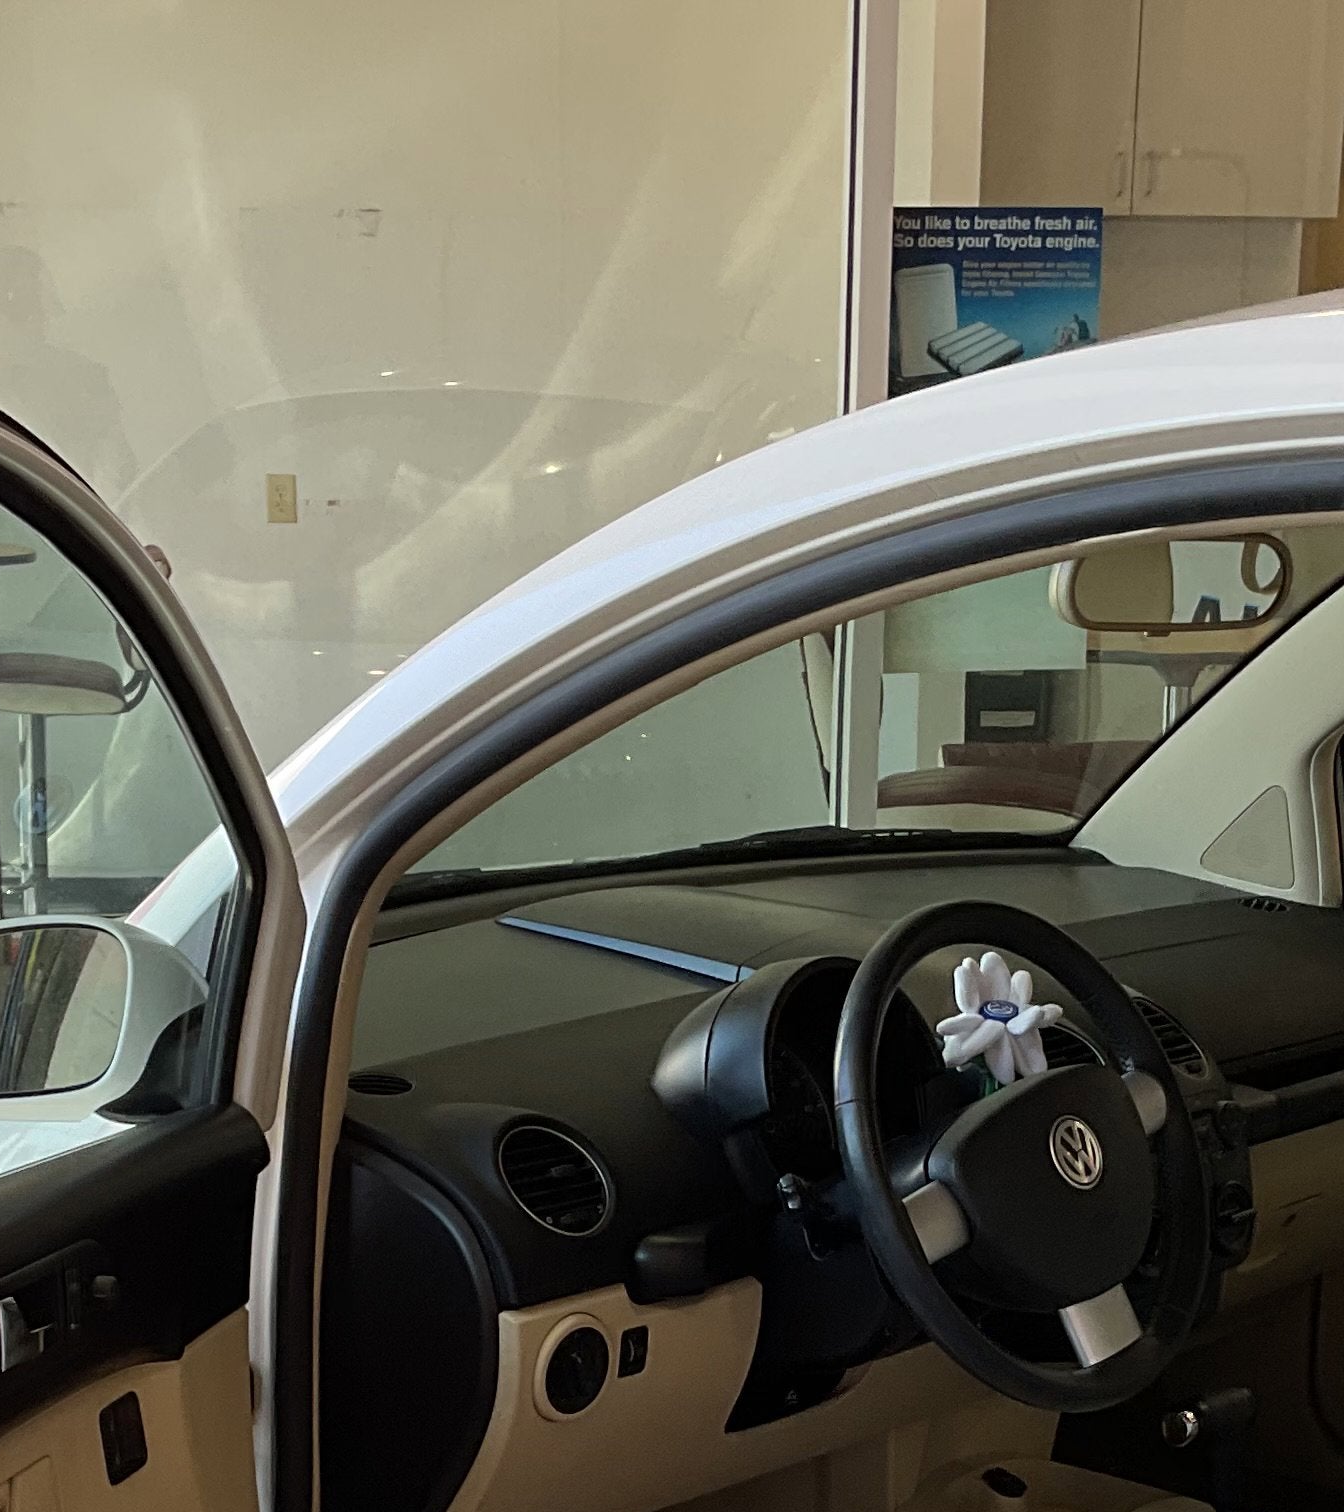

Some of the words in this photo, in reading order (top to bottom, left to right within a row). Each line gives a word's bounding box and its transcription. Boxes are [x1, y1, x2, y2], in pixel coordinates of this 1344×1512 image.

[894, 216, 921, 230] You
[925, 216, 951, 230] like
[955, 216, 970, 230] to
[974, 216, 1031, 230] breathe
[1035, 216, 1071, 230] fresh
[1076, 217, 1098, 230] air.
[894, 234, 914, 248] So
[918, 234, 954, 248] does
[957, 236, 990, 250] your
[994, 234, 1042, 251] Toyota
[1046, 235, 1100, 250] engine.
